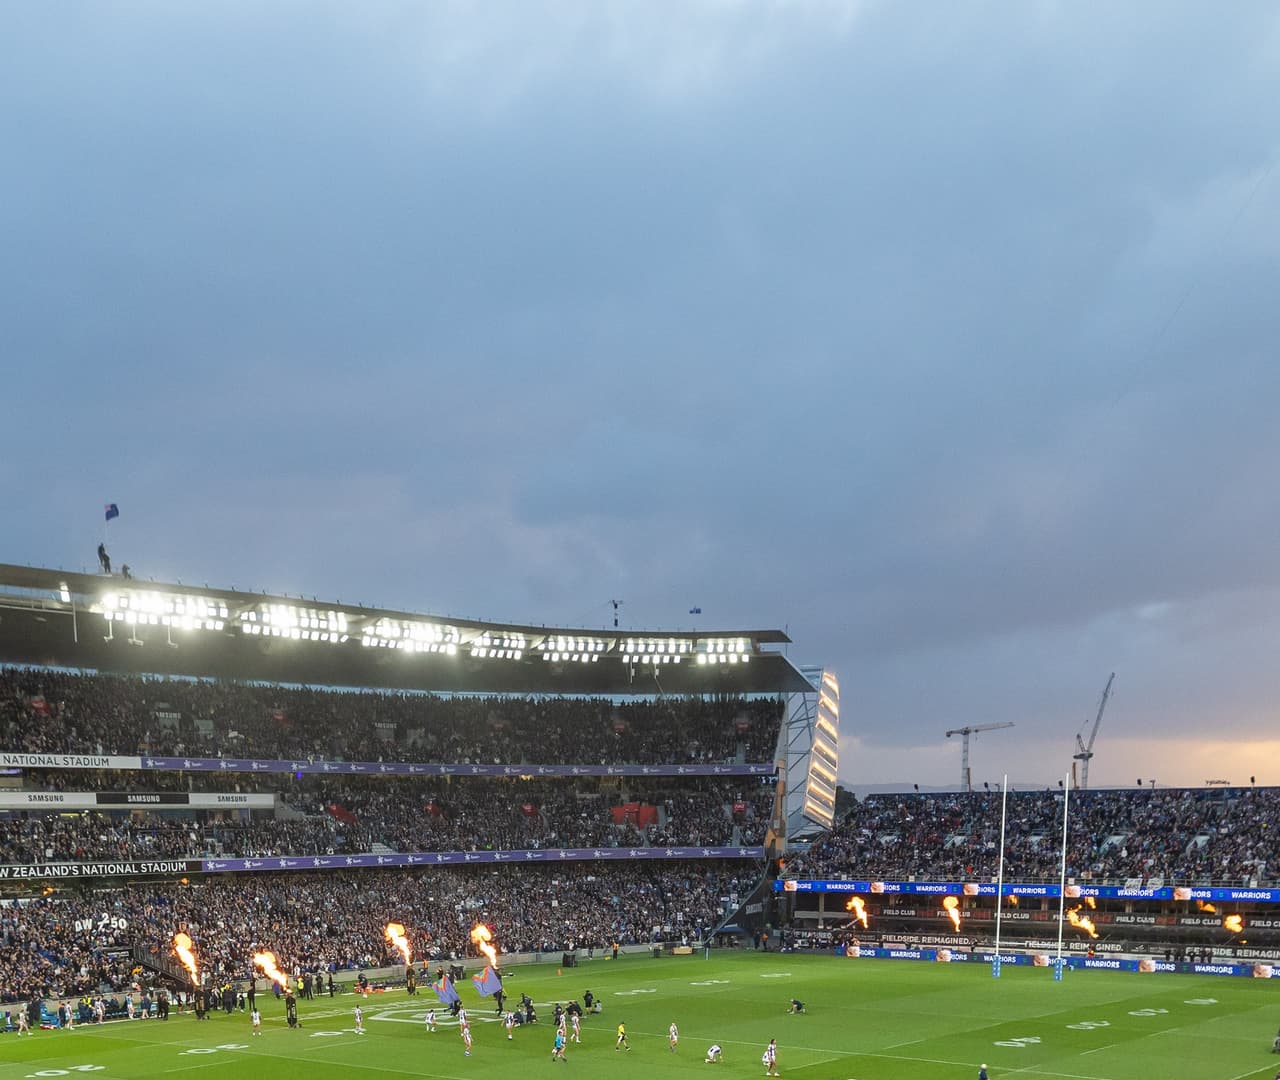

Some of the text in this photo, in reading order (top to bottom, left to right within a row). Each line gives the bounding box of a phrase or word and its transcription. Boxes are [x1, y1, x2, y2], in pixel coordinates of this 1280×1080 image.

[4, 755, 60, 767] NATIONAL
[63, 757, 110, 767] STADIUM
[27, 794, 64, 803] SAMSUNG
[127, 795, 161, 803] SAMSUNG
[217, 795, 248, 803] SAMSUNG
[12, 865, 79, 877] ZEALAND'S
[82, 864, 139, 875] NATIONAL
[140, 862, 187, 873] STADIUM
[1117, 889, 1154, 897] WARRIORS
[1191, 890, 1211, 898] RIORS
[1231, 891, 1271, 899] WARRIORS
[882, 934, 971, 945] FIELDSIDE. REIMAGINED.
[1069, 942, 1124, 952] REIMGINED.
[859, 949, 875, 957] RIORS
[1085, 959, 1120, 968] WARRIORS
[1155, 963, 1176, 971] RIORS
[1195, 965, 1233, 974] WARRIORS
[34, 1064, 107, 1077] 20
